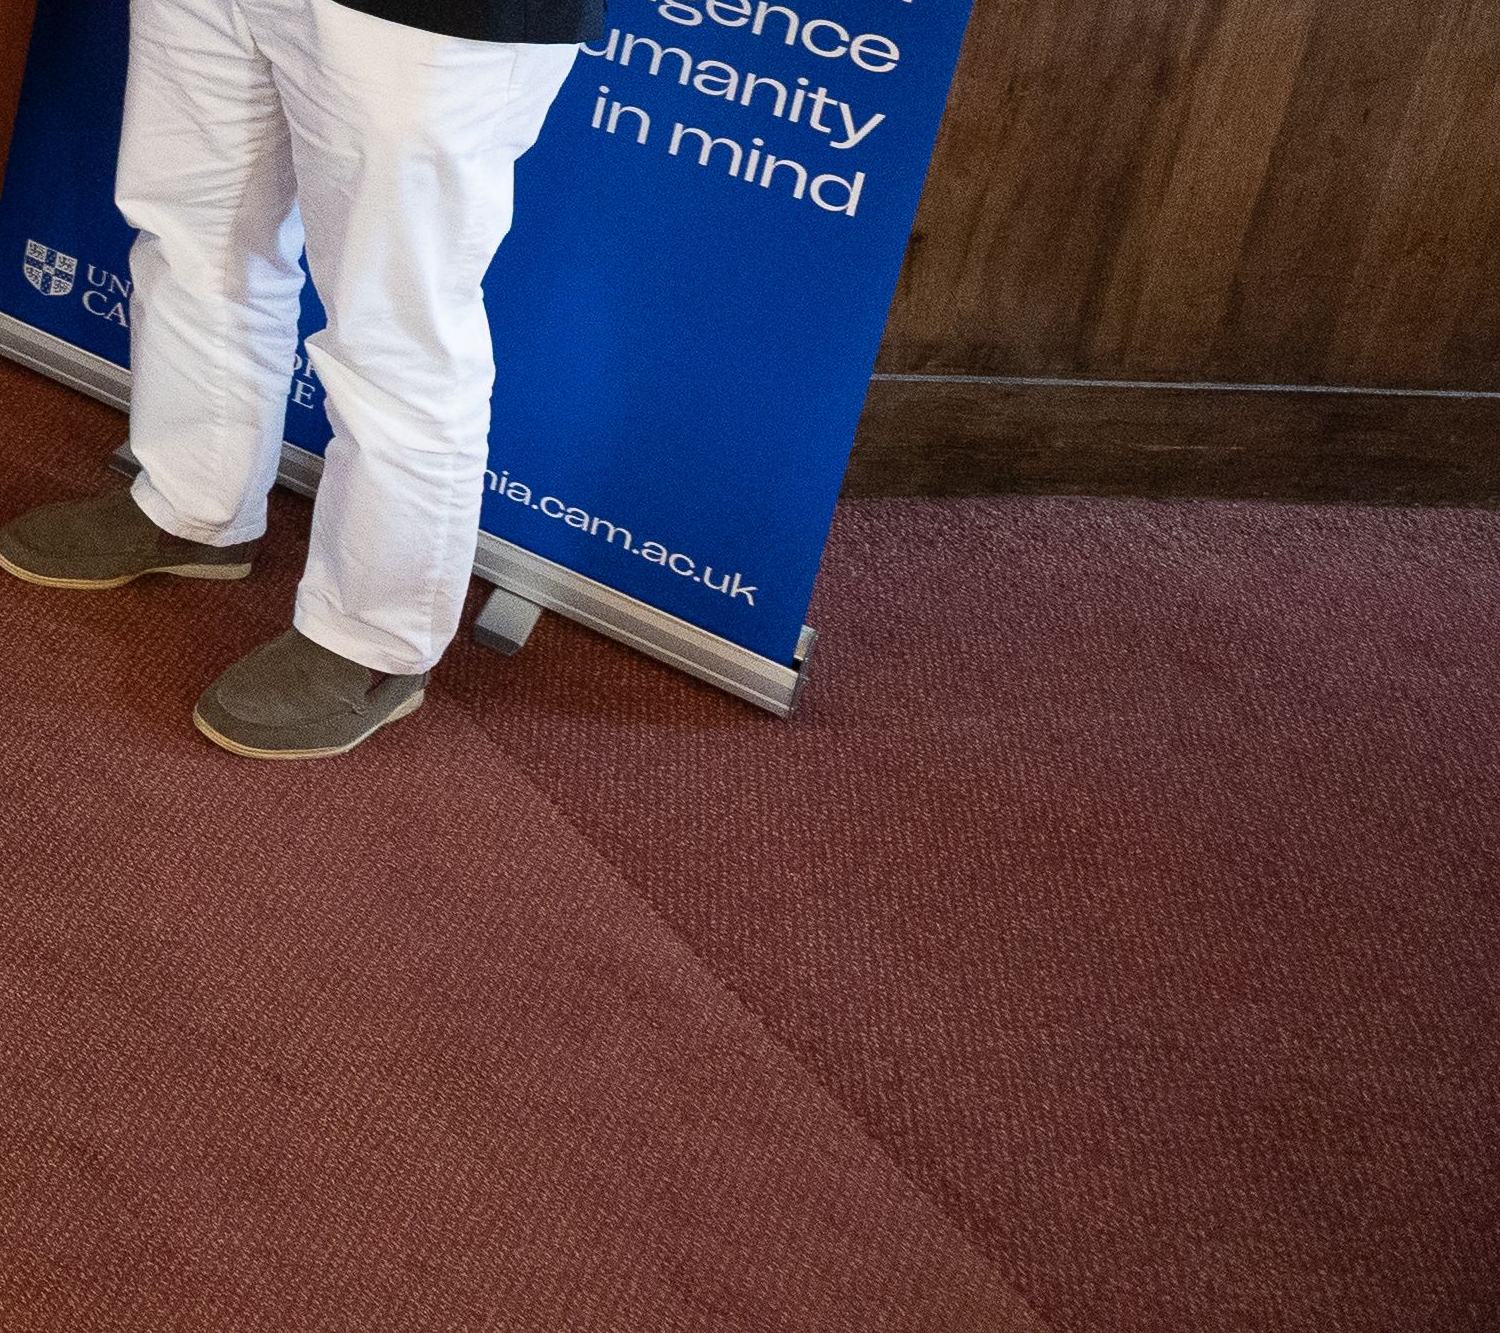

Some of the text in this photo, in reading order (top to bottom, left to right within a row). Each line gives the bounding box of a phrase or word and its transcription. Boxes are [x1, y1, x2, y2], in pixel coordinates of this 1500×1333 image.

[580, 28, 886, 151] umanity
[591, 85, 866, 219] in mind
